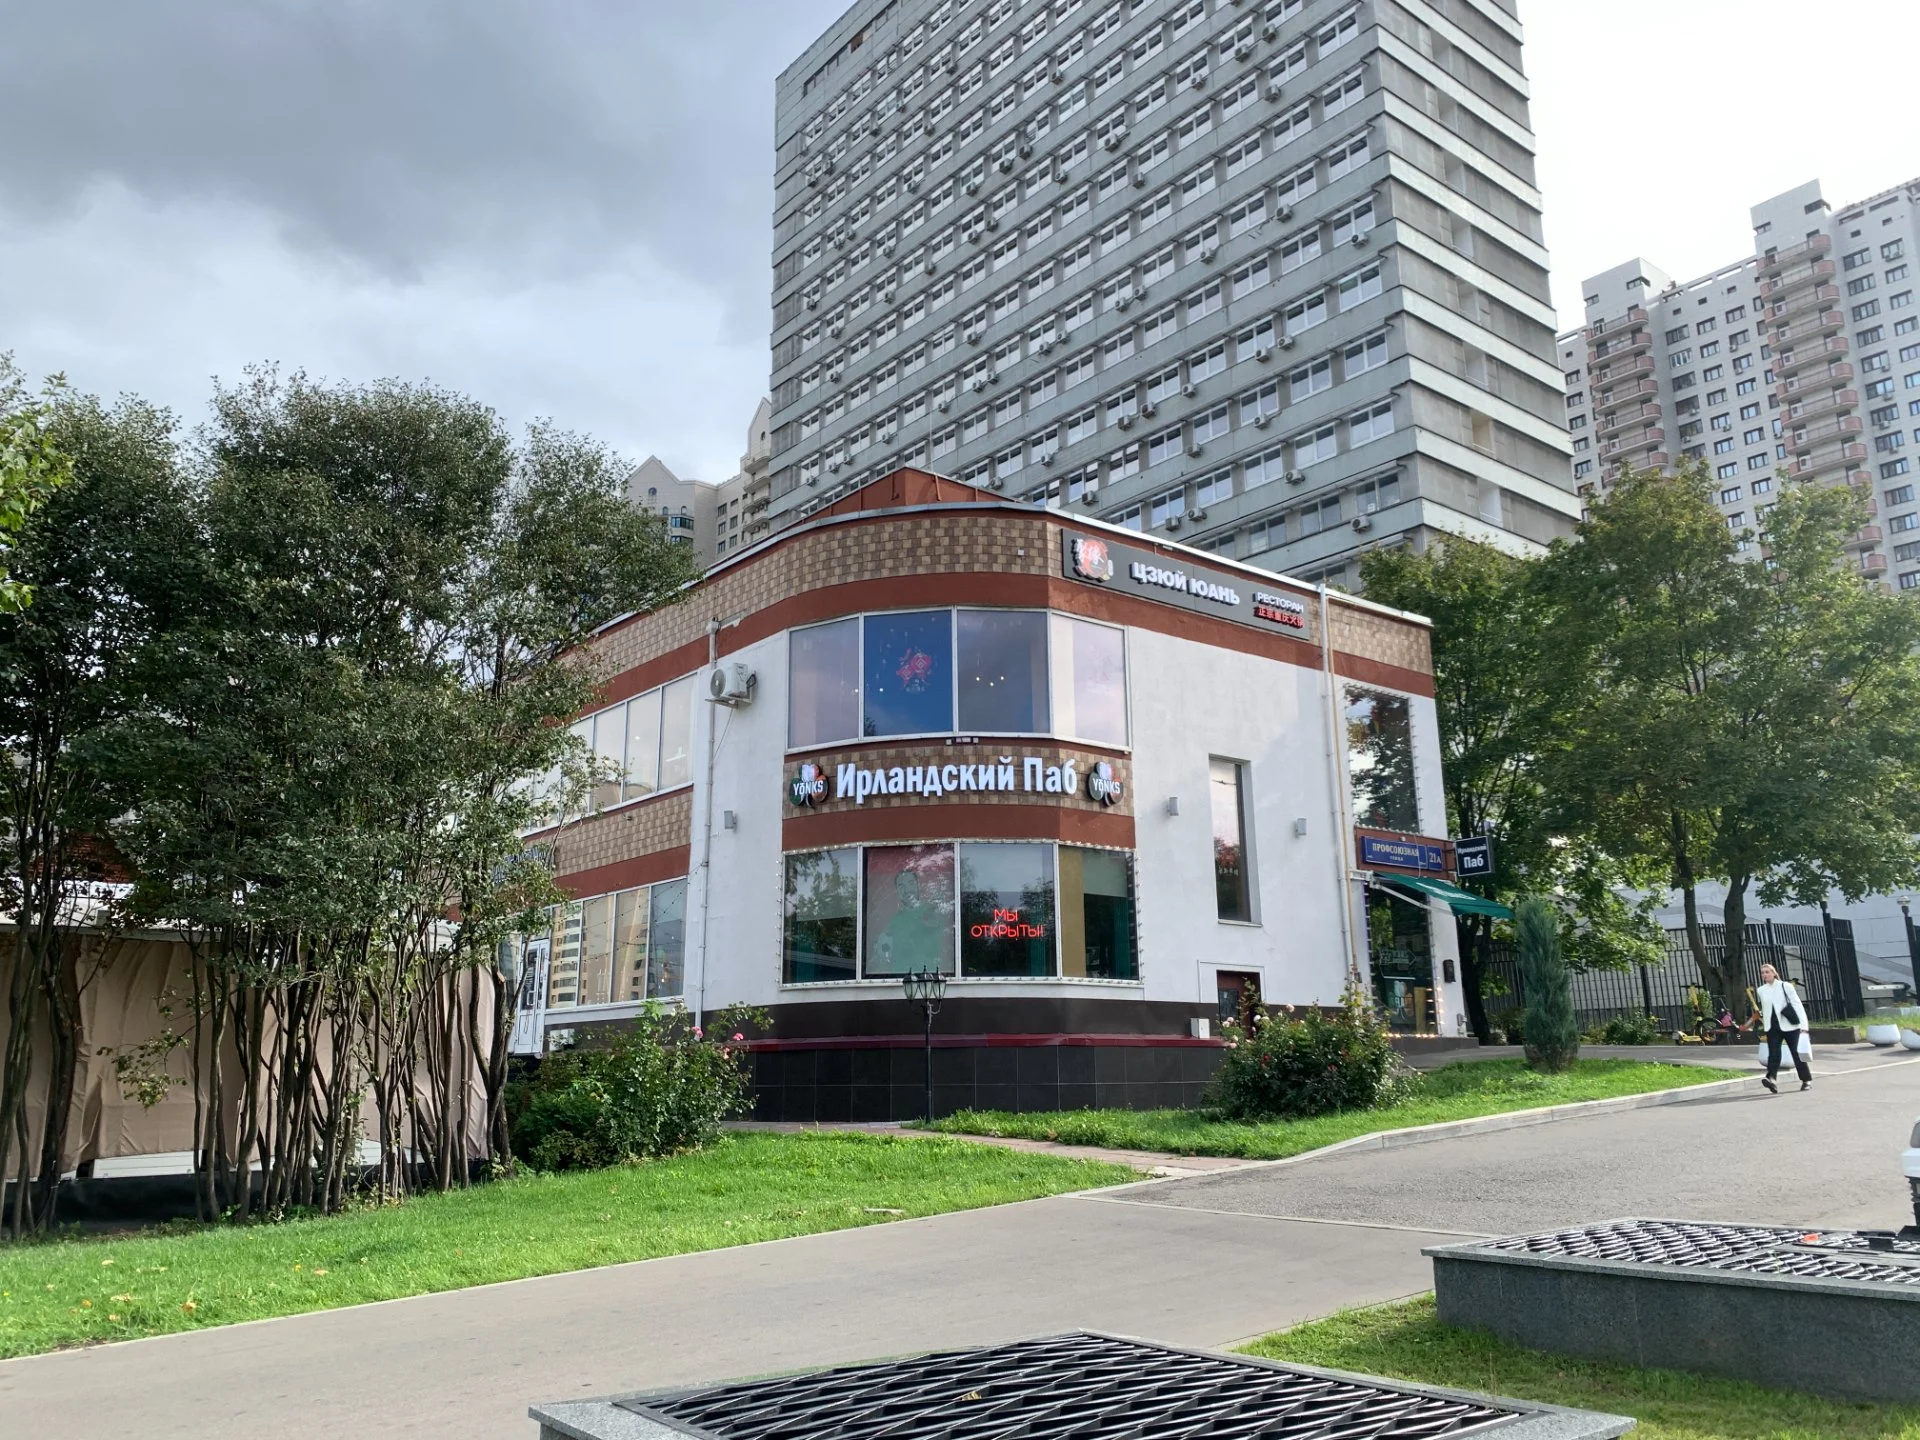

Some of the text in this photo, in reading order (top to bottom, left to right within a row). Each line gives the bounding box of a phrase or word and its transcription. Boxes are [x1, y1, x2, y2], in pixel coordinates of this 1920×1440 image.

[1131, 561, 1240, 605] ЦЗЮЙ ЮАНЬ
[1257, 592, 1304, 613] РЕСТОРАН
[836, 756, 1078, 804] Ирландский Паб
[1463, 854, 1484, 869] Паб
[993, 908, 1018, 922] МЫ
